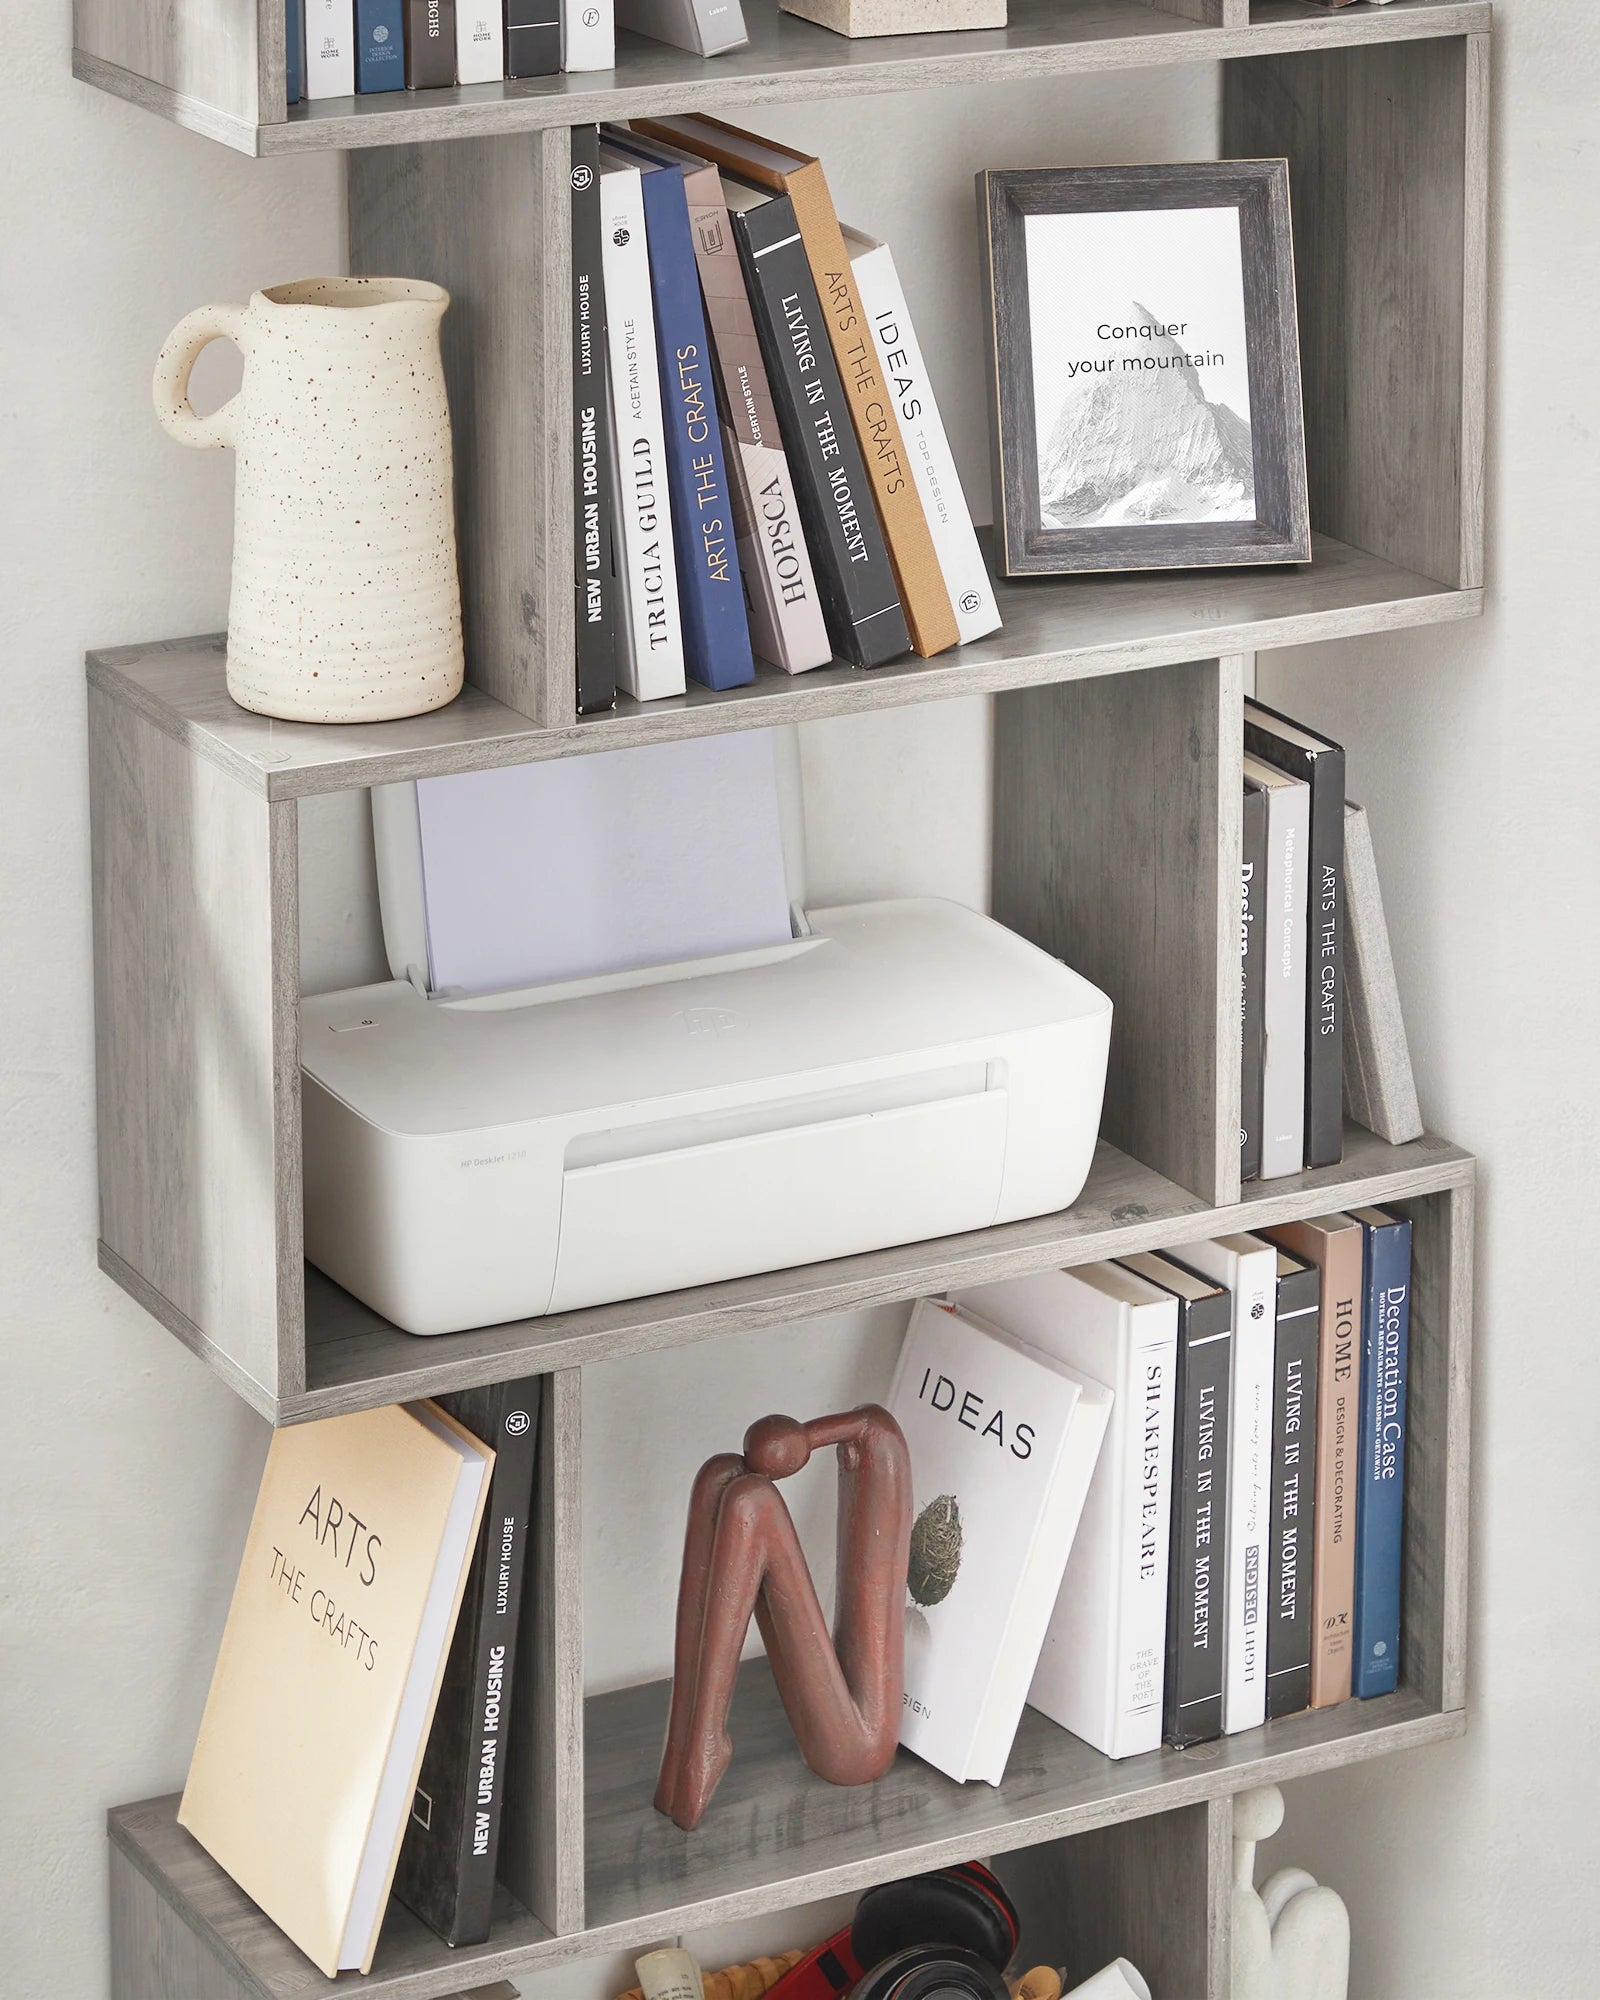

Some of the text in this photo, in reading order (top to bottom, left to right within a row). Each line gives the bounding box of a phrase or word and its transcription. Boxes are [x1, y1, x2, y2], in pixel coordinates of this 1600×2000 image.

[579, 274, 593, 375] LUXURY HOUSE
[624, 319, 643, 420] A CETAIN STYLE
[737, 365, 752, 398] STYLE
[824, 271, 905, 496] ARTS THE CRAFTS
[875, 310, 922, 422] IDEAS
[1068, 350, 1225, 378] your mountain
[1097, 323, 1188, 341] Conquer
[677, 344, 731, 582] ARTS THE CRAFTS
[744, 397, 762, 441] CERTAIN
[781, 292, 869, 563] LIVING IN THE MOMENT
[916, 430, 949, 524] TOP DESIGN
[581, 406, 602, 623] NEW URBAN HOUSING
[632, 437, 668, 651] TRICIA GUILD
[759, 475, 807, 607] HOPSCA
[1282, 828, 1295, 978] Metaphorical Concepts
[1321, 865, 1336, 1035] ARTS THE CRAFTS
[460, 1159, 472, 1168] HP
[919, 1367, 1036, 1460] IDEAS
[1333, 1298, 1353, 1544] HOME DESIGN & DECORATING
[1374, 1292, 1386, 1481] HOTELS RESTAURANTS GARDENS GETAWAYS
[1382, 1285, 1406, 1480] Decoration Case
[298, 1484, 382, 1586] ARTS
[1141, 1366, 1162, 1580] SHAKESPEARE
[1193, 1385, 1216, 1649] LIVING IN THE MOMENT
[1280, 1359, 1303, 1620] LIVING IN THE MOMENT
[270, 1546, 379, 1671] THE CRAFTS
[496, 1516, 515, 1615] LUXURY HOUSE
[1244, 1545, 1259, 1683] LIGHT DESIGNS
[472, 1646, 506, 1857] NEW URBAN HOUSING
